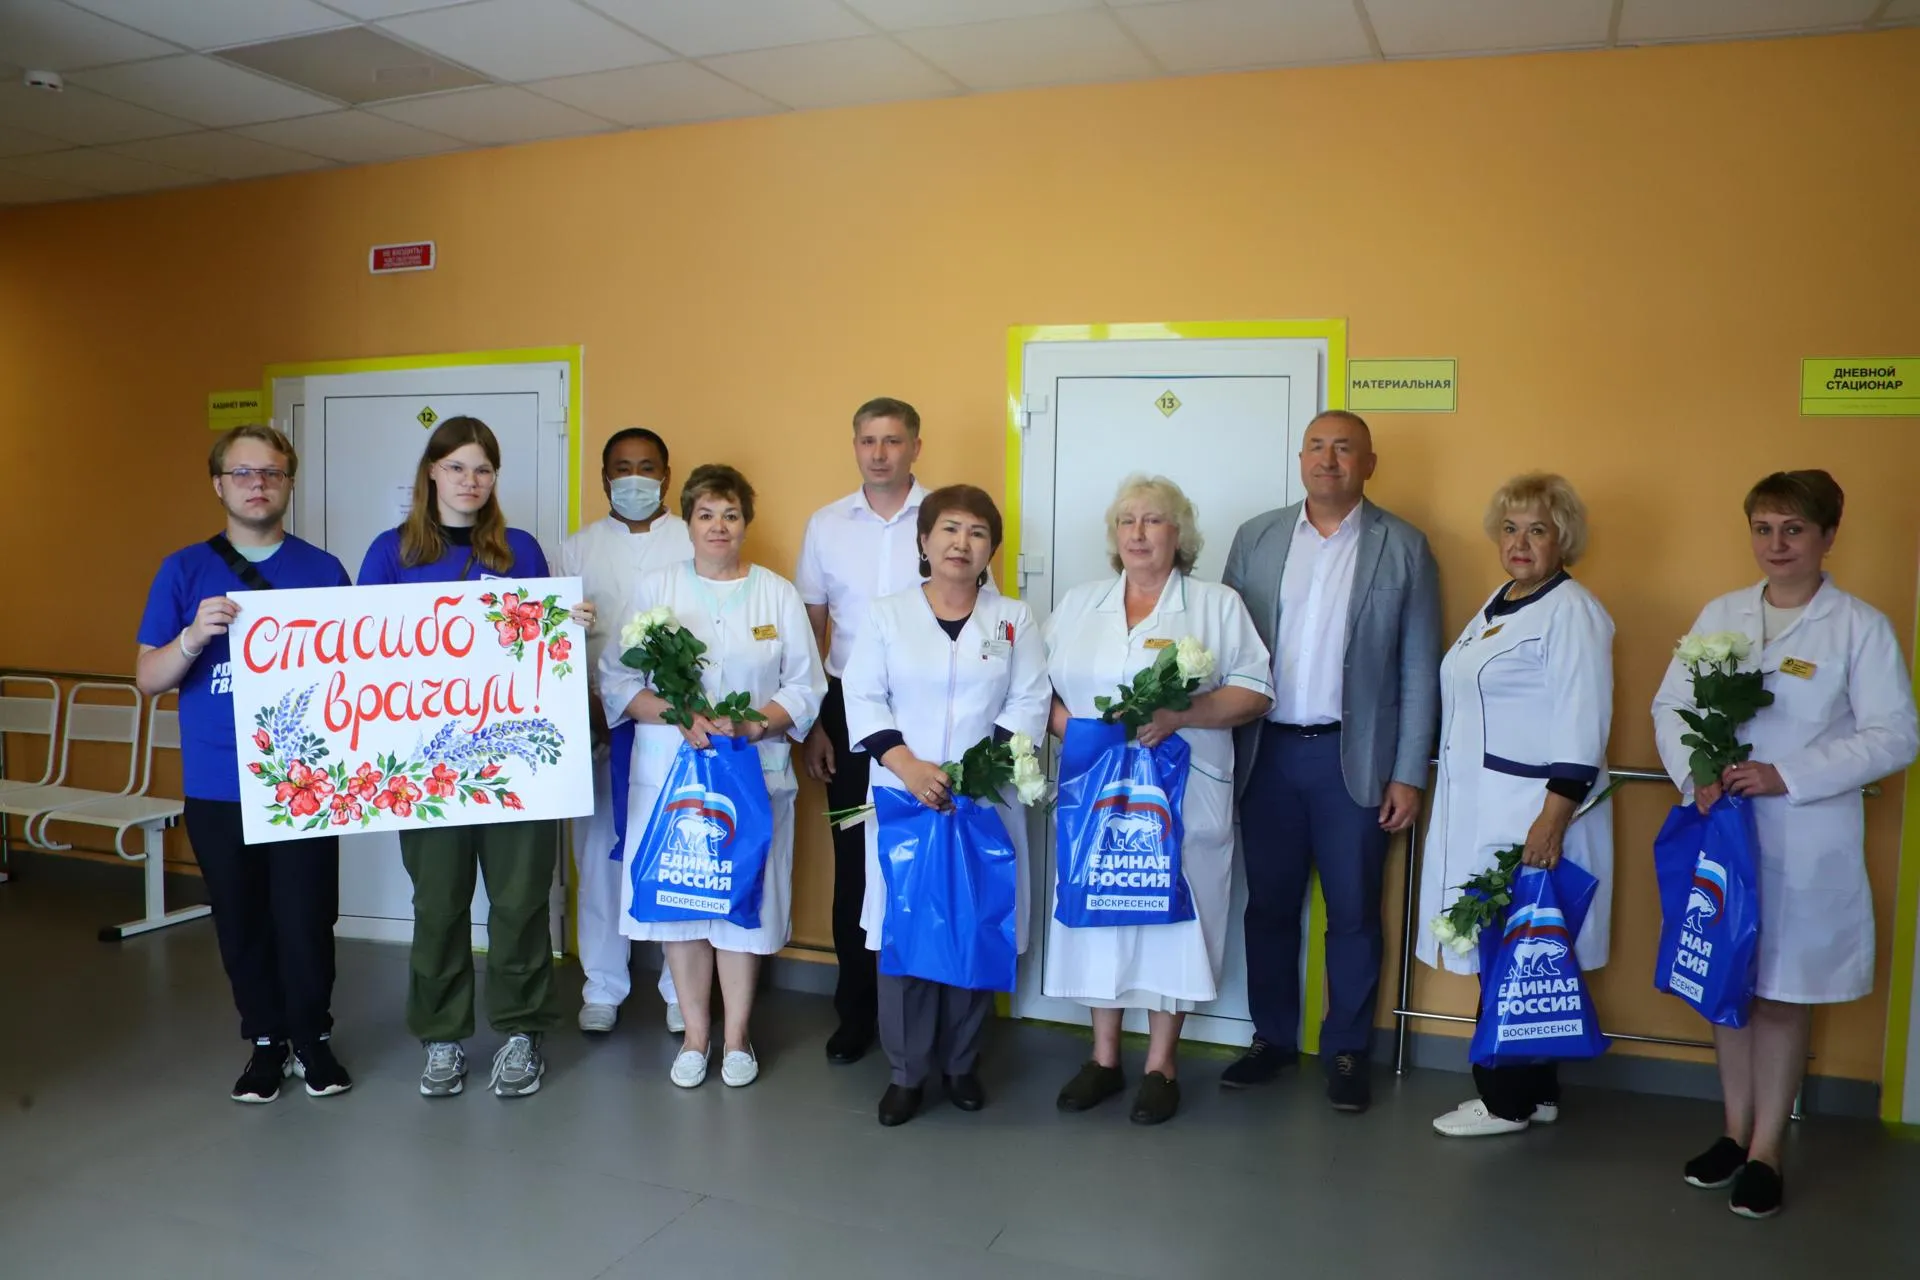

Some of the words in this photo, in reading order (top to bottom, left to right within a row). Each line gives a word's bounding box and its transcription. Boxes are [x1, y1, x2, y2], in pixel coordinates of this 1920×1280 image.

[1834, 366, 1896, 379] ДНЕВНОЙ
[1352, 379, 1451, 389] МАТЕРИАЛЬНАЯ
[1826, 380, 1903, 391] СТАЦИОНАР
[1161, 397, 1175, 409] 13
[421, 412, 433, 422] 12
[243, 594, 475, 674] Спасибо
[323, 641, 545, 751] врачам!
[660, 852, 733, 874] ЕДИНАЯ
[1089, 854, 1171, 870] ЕДИНАЯ
[658, 868, 732, 891] РОССИЯ
[1088, 871, 1171, 888] РОССИЯ
[660, 894, 725, 911] ВОСКРЕСЕНСК
[1090, 898, 1164, 908] ВОСКРЕСЕНСК
[1680, 930, 1713, 958] НАЯ
[1677, 949, 1710, 977] СИЯ
[1498, 977, 1579, 998] ЕДИНАЯ
[1671, 976, 1700, 997] ЕСЕНСК
[1497, 995, 1581, 1016] РОССИЯ
[1502, 1023, 1578, 1037] ВОСКРЕСЕНСК
